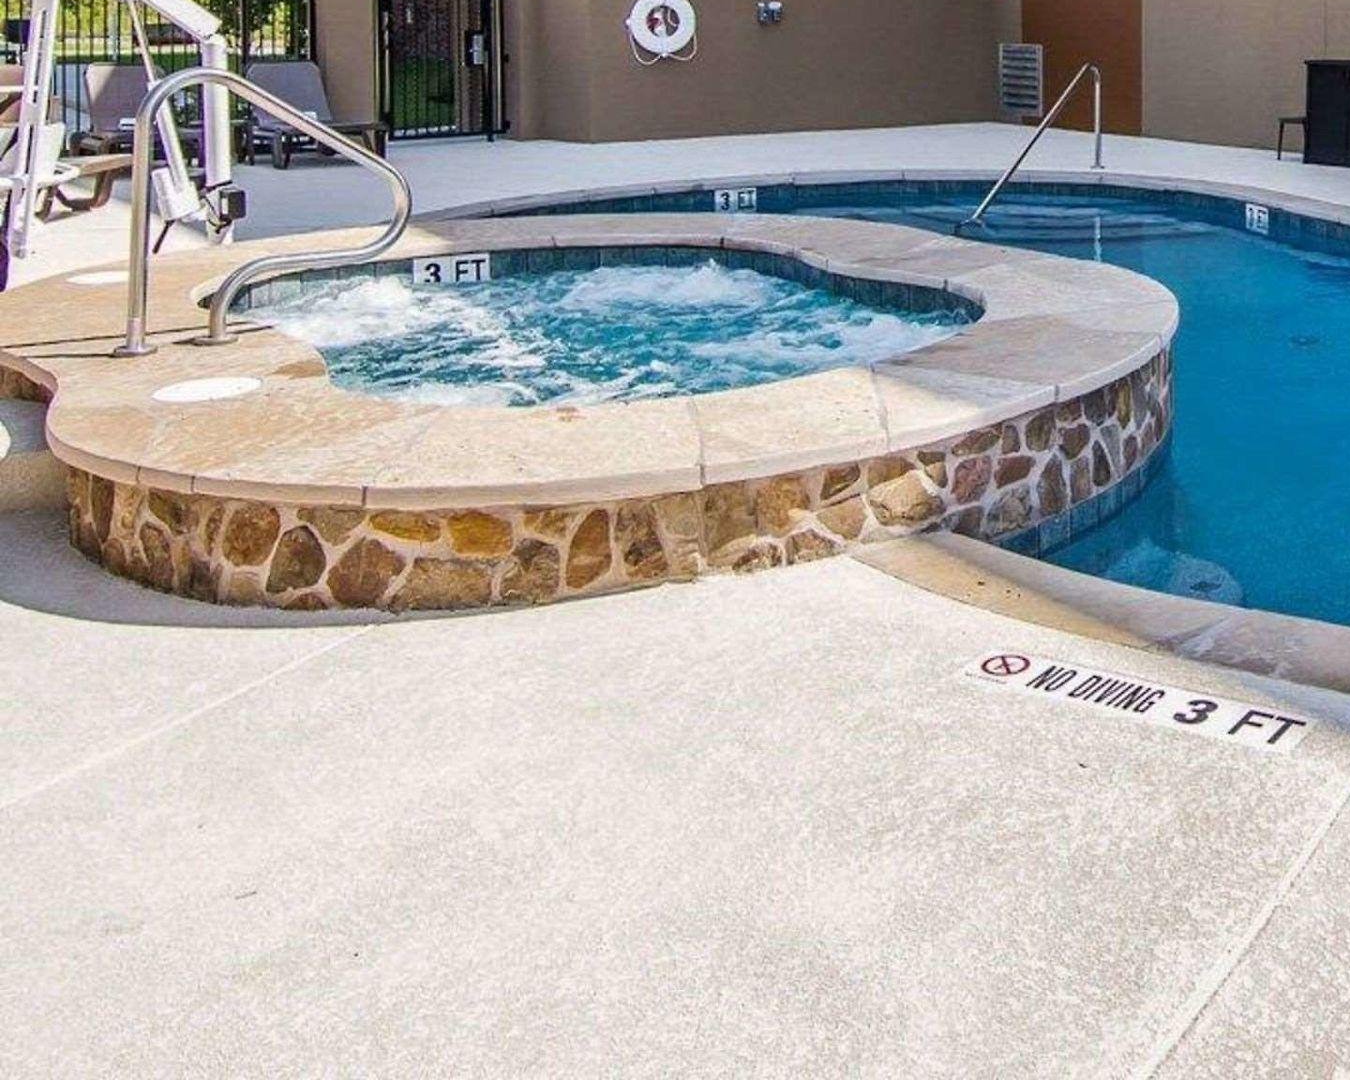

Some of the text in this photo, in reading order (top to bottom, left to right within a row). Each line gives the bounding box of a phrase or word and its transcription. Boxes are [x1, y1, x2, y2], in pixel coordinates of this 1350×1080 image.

[719, 191, 731, 211] 3
[424, 259, 487, 283] 3 FT
[1026, 664, 1077, 692] NO
[1068, 674, 1166, 714] DIVING
[1173, 698, 1219, 725] 3
[1227, 709, 1307, 745] FT
